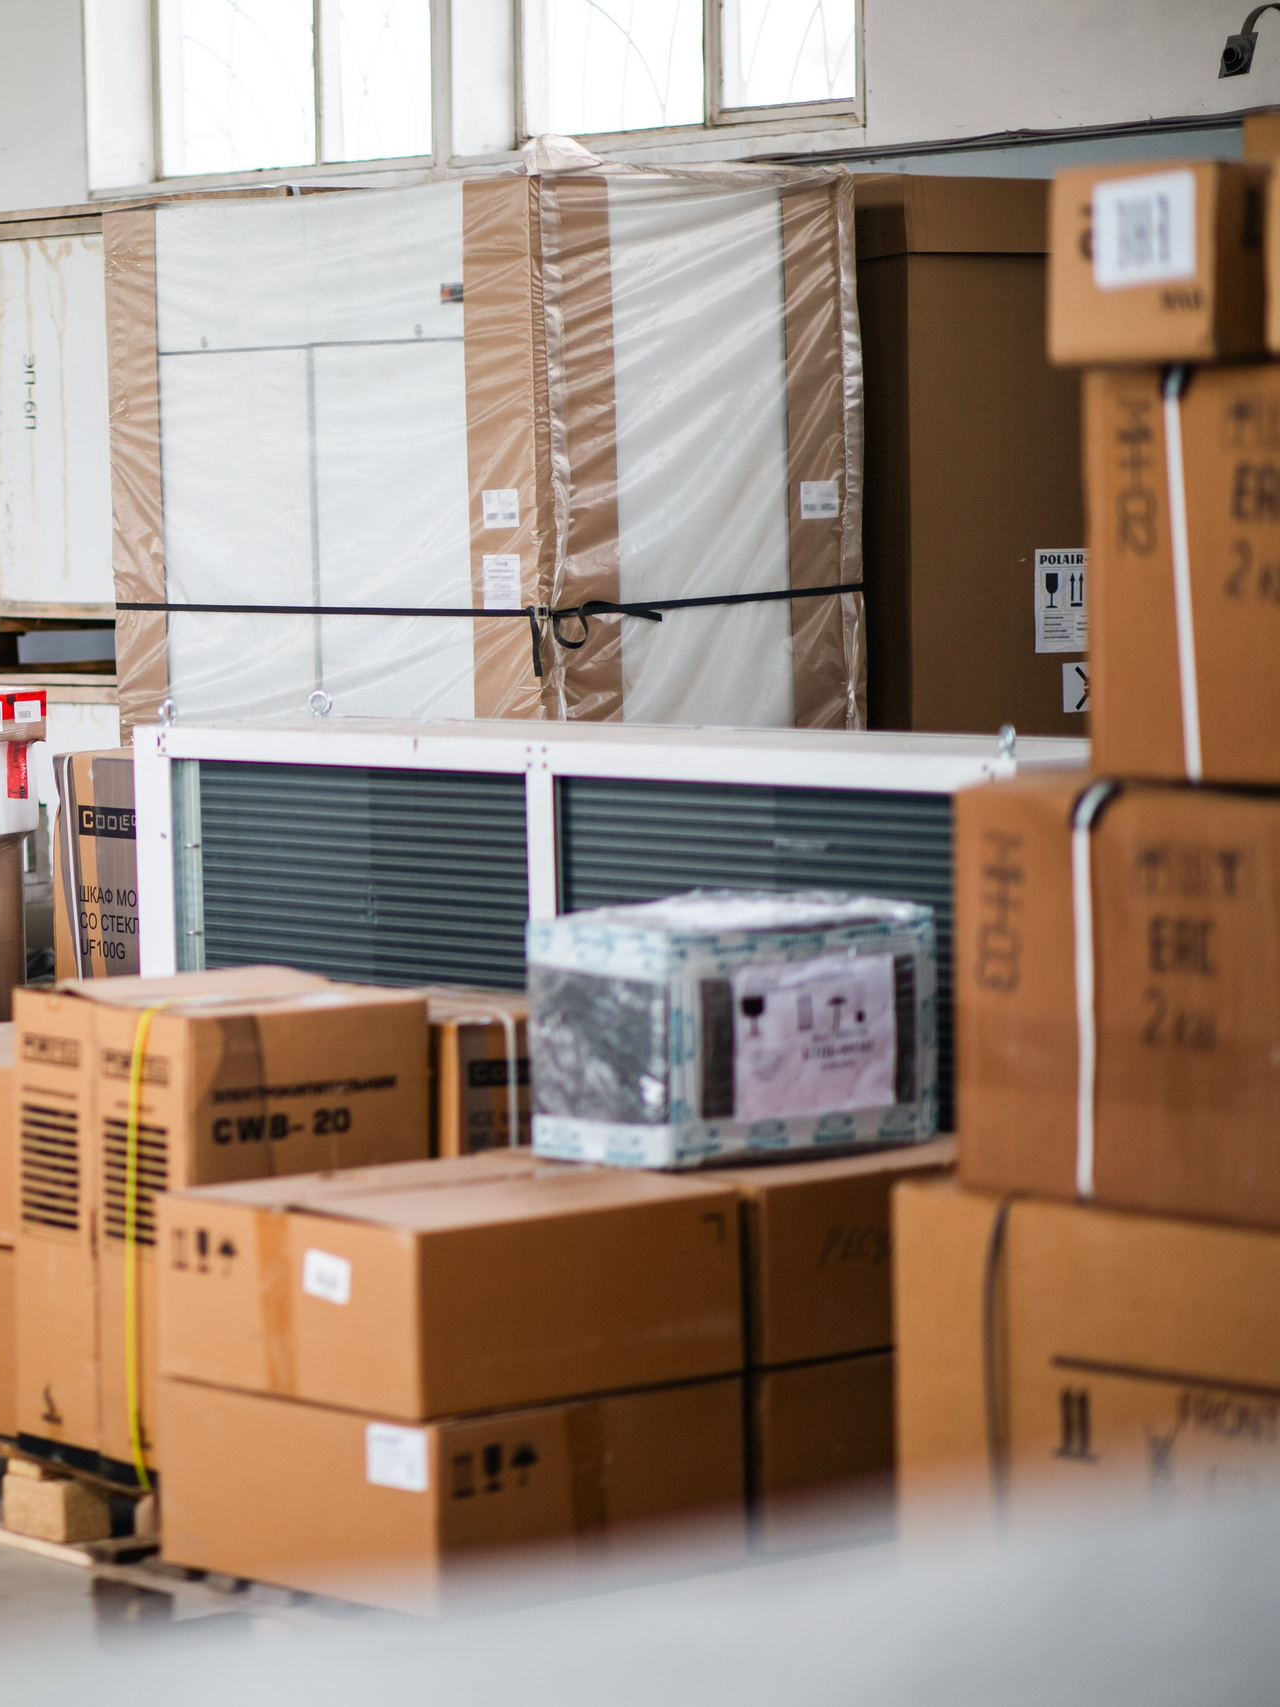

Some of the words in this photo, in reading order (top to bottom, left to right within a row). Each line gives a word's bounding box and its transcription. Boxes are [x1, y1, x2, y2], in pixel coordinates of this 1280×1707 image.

[1040, 554, 1084, 565] POLAIR
[79, 885, 113, 905] ШКАФ
[116, 889, 137, 908] МО
[80, 911, 98, 930] СО
[101, 914, 140, 935] СТЕКЛ
[80, 938, 126, 960] UF100G
